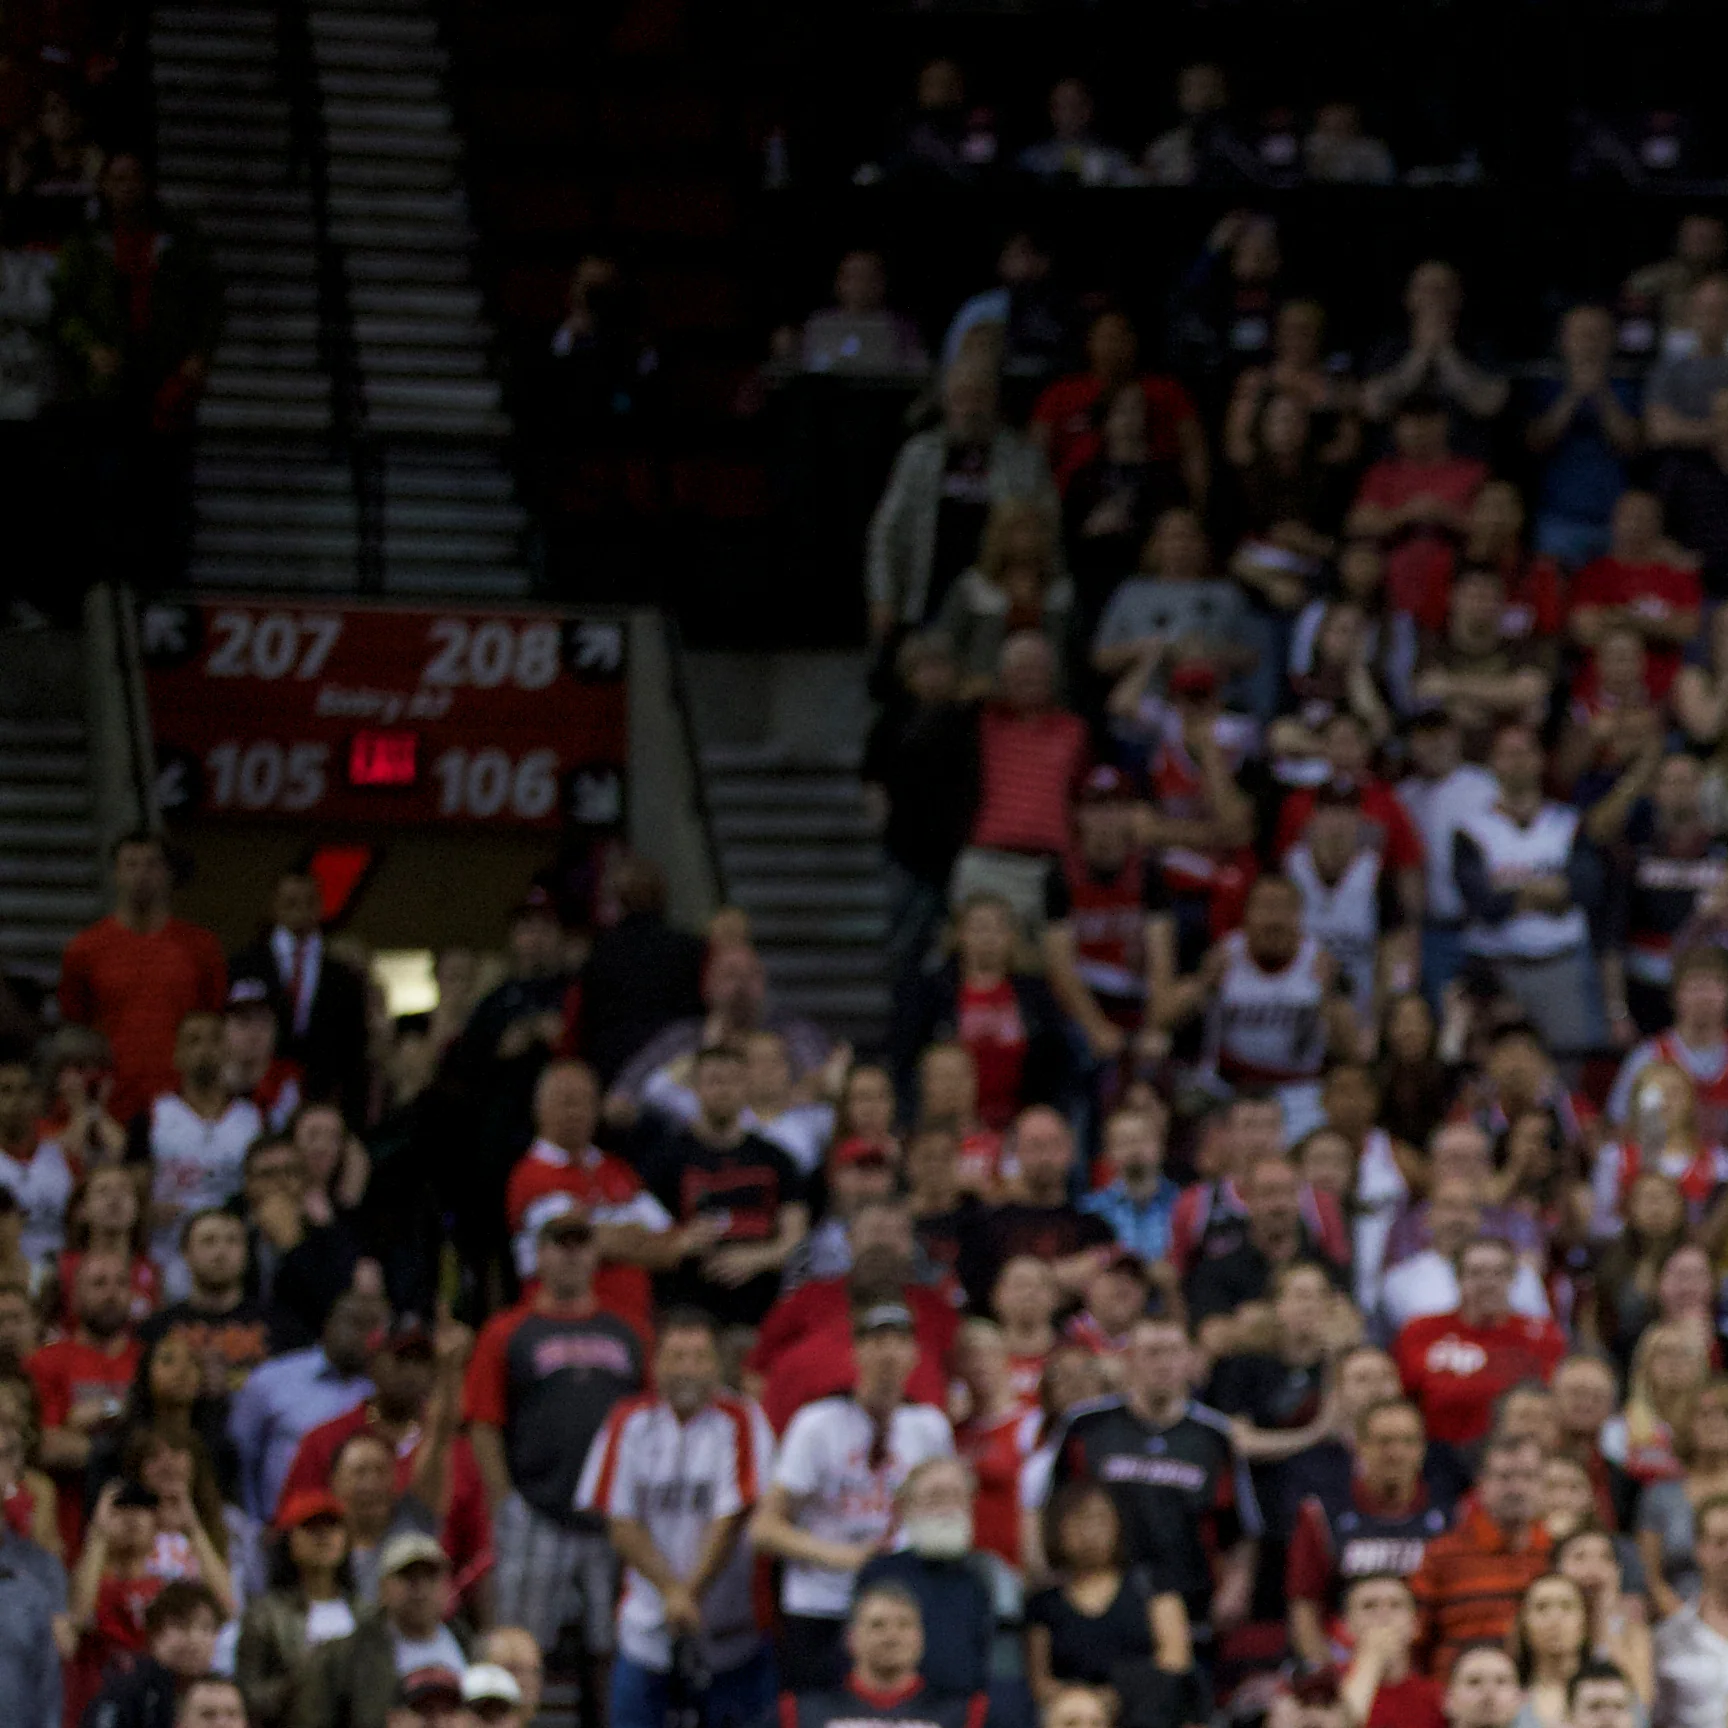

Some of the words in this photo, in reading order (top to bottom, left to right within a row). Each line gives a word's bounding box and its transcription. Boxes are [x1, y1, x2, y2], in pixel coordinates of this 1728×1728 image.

[205, 612, 345, 681] 207
[420, 618, 563, 690] 208
[205, 738, 330, 811] 105
[431, 746, 561, 819] 106
